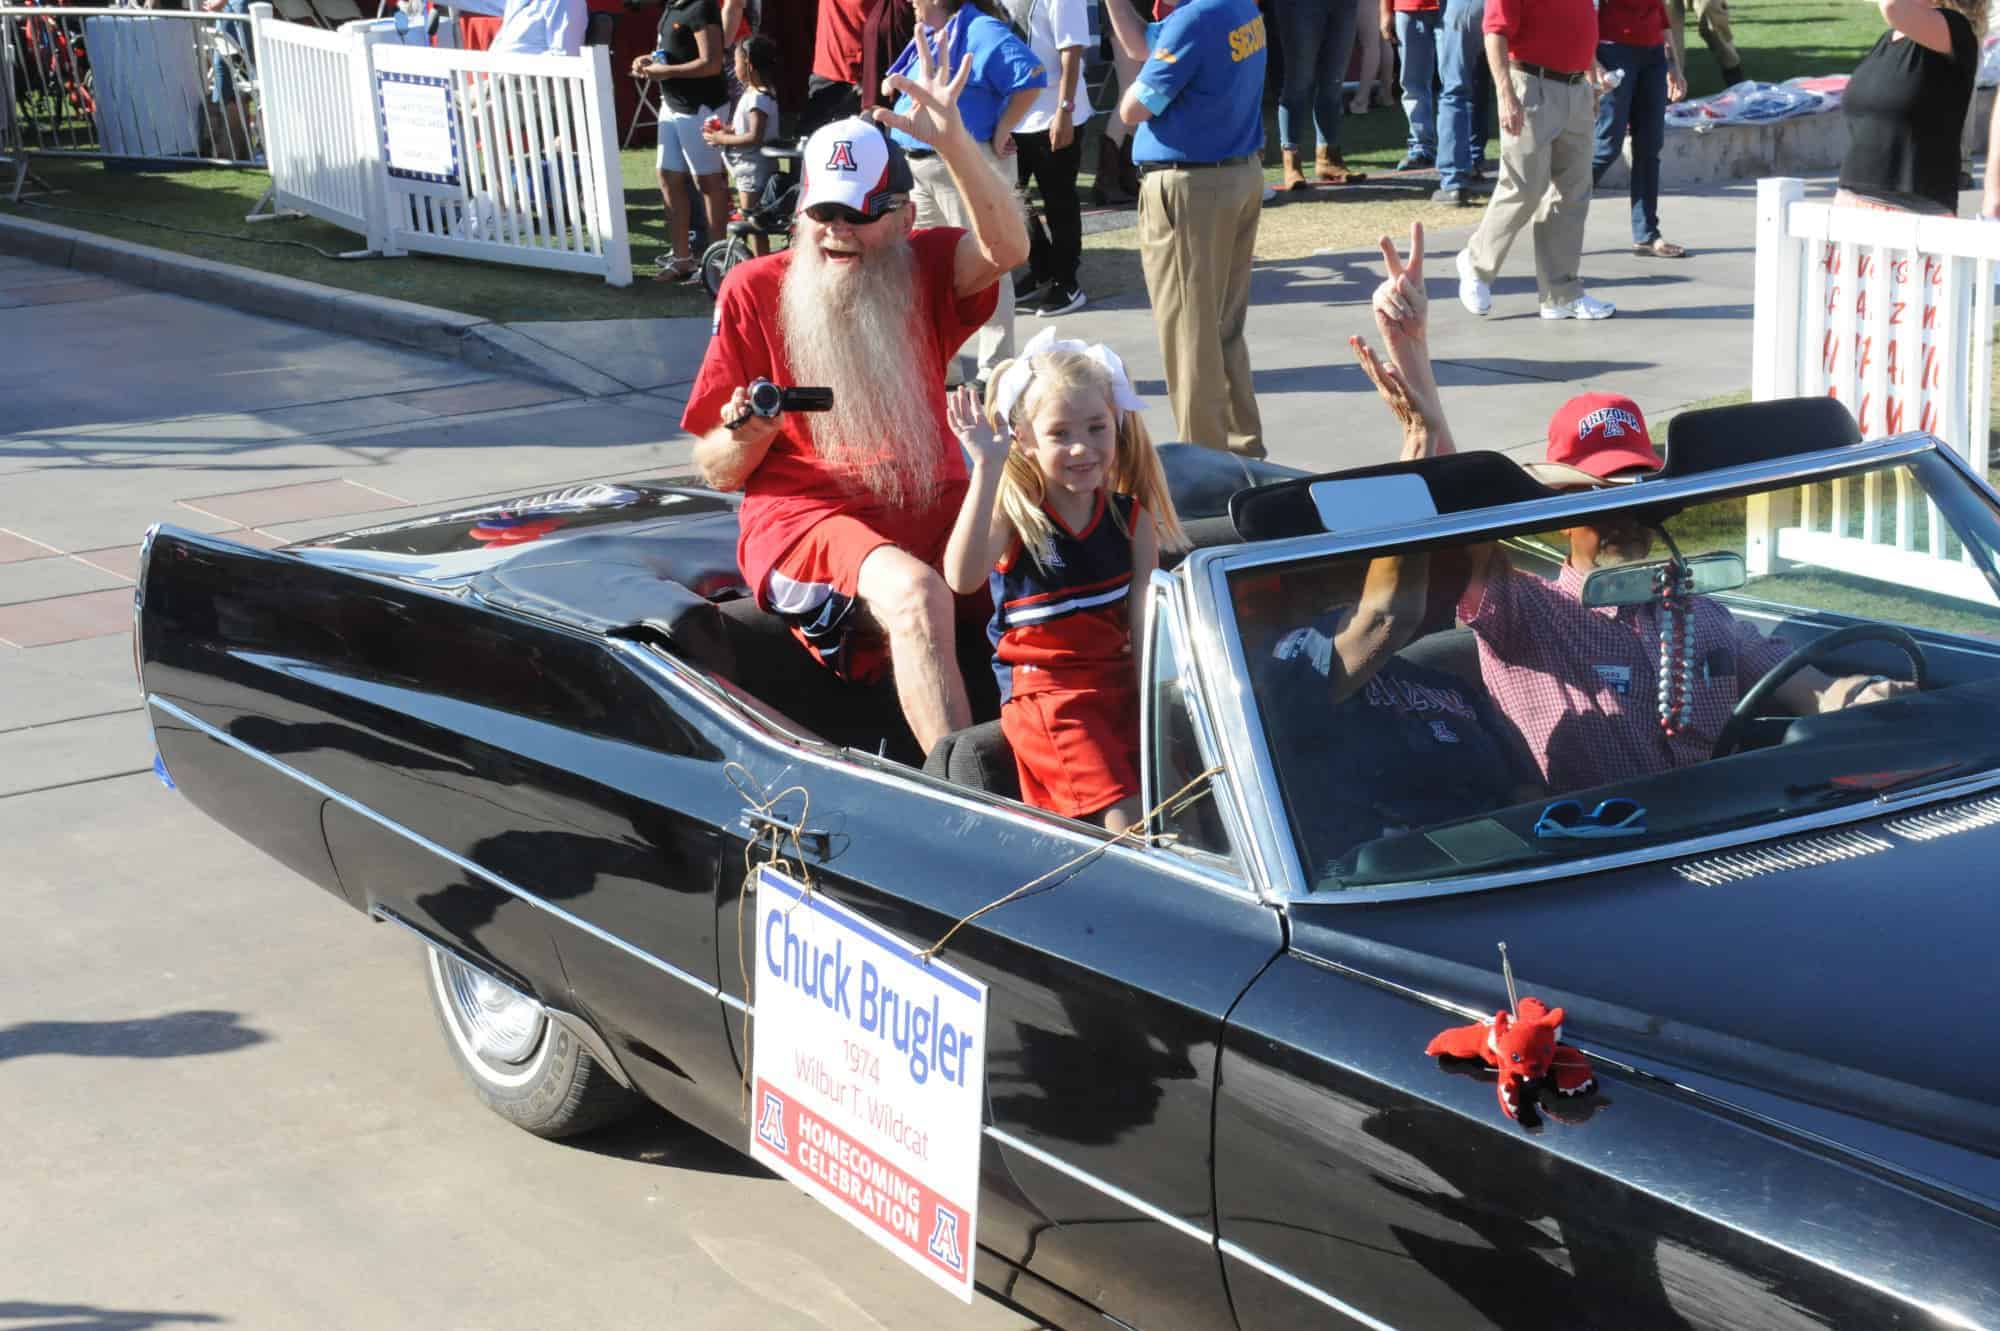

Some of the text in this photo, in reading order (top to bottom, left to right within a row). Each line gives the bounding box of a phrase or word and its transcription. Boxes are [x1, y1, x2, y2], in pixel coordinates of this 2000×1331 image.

[825, 140, 857, 171] A
[1579, 407, 1641, 440] ARIZONA
[764, 908, 973, 1088] Chuck Brugler
[843, 1039, 881, 1086] 1974
[759, 1092, 788, 1153] A
[793, 1047, 929, 1160] Wilbur T. Wildcat
[797, 1141, 921, 1243] CELEBRATION
[798, 1113, 921, 1214] HOMECOMING
[928, 1206, 961, 1269] A
